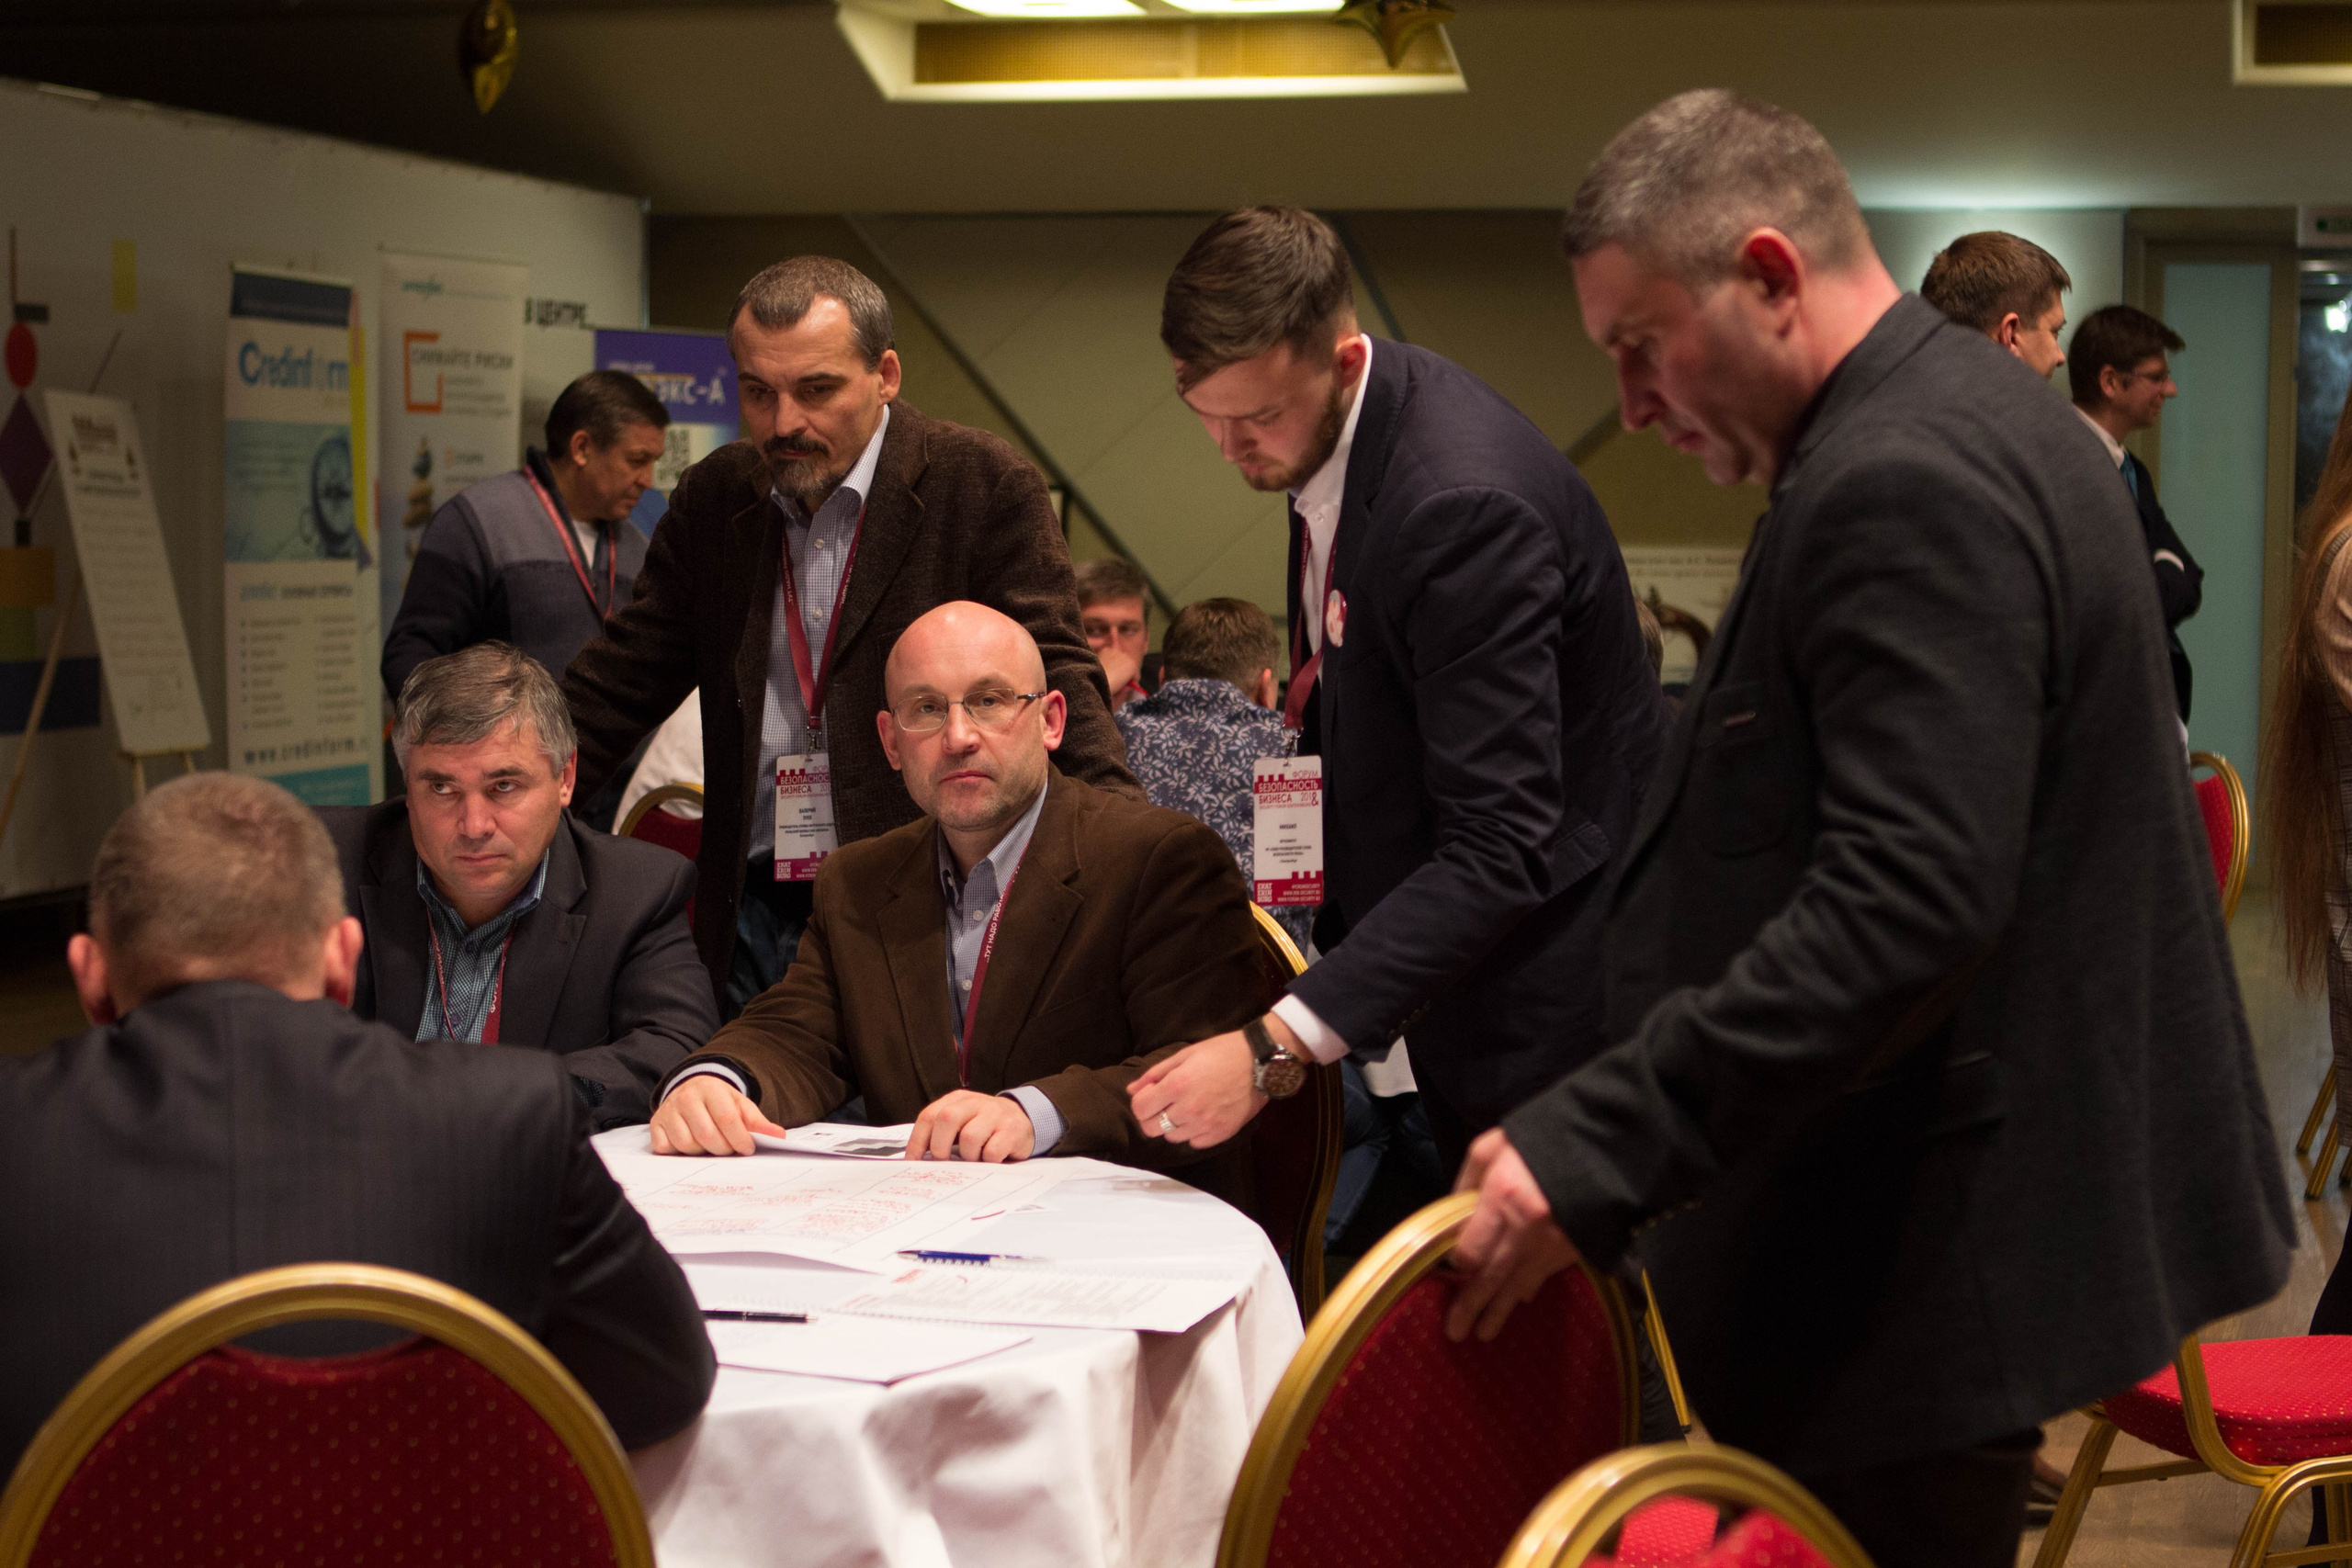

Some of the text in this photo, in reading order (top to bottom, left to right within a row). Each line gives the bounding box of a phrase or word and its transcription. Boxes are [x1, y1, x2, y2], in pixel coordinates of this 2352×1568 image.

[780, 773, 831, 785] БЕЗОПАСНОС
[1292, 770, 1318, 779] ФОРУМ
[780, 784, 812, 795] БИЗНЕСА
[1259, 779, 1318, 794] БЕЗОПАСНОСТЬ
[1259, 793, 1293, 805] БИЗНЕСА
[988, 922, 998, 944] НАДО
